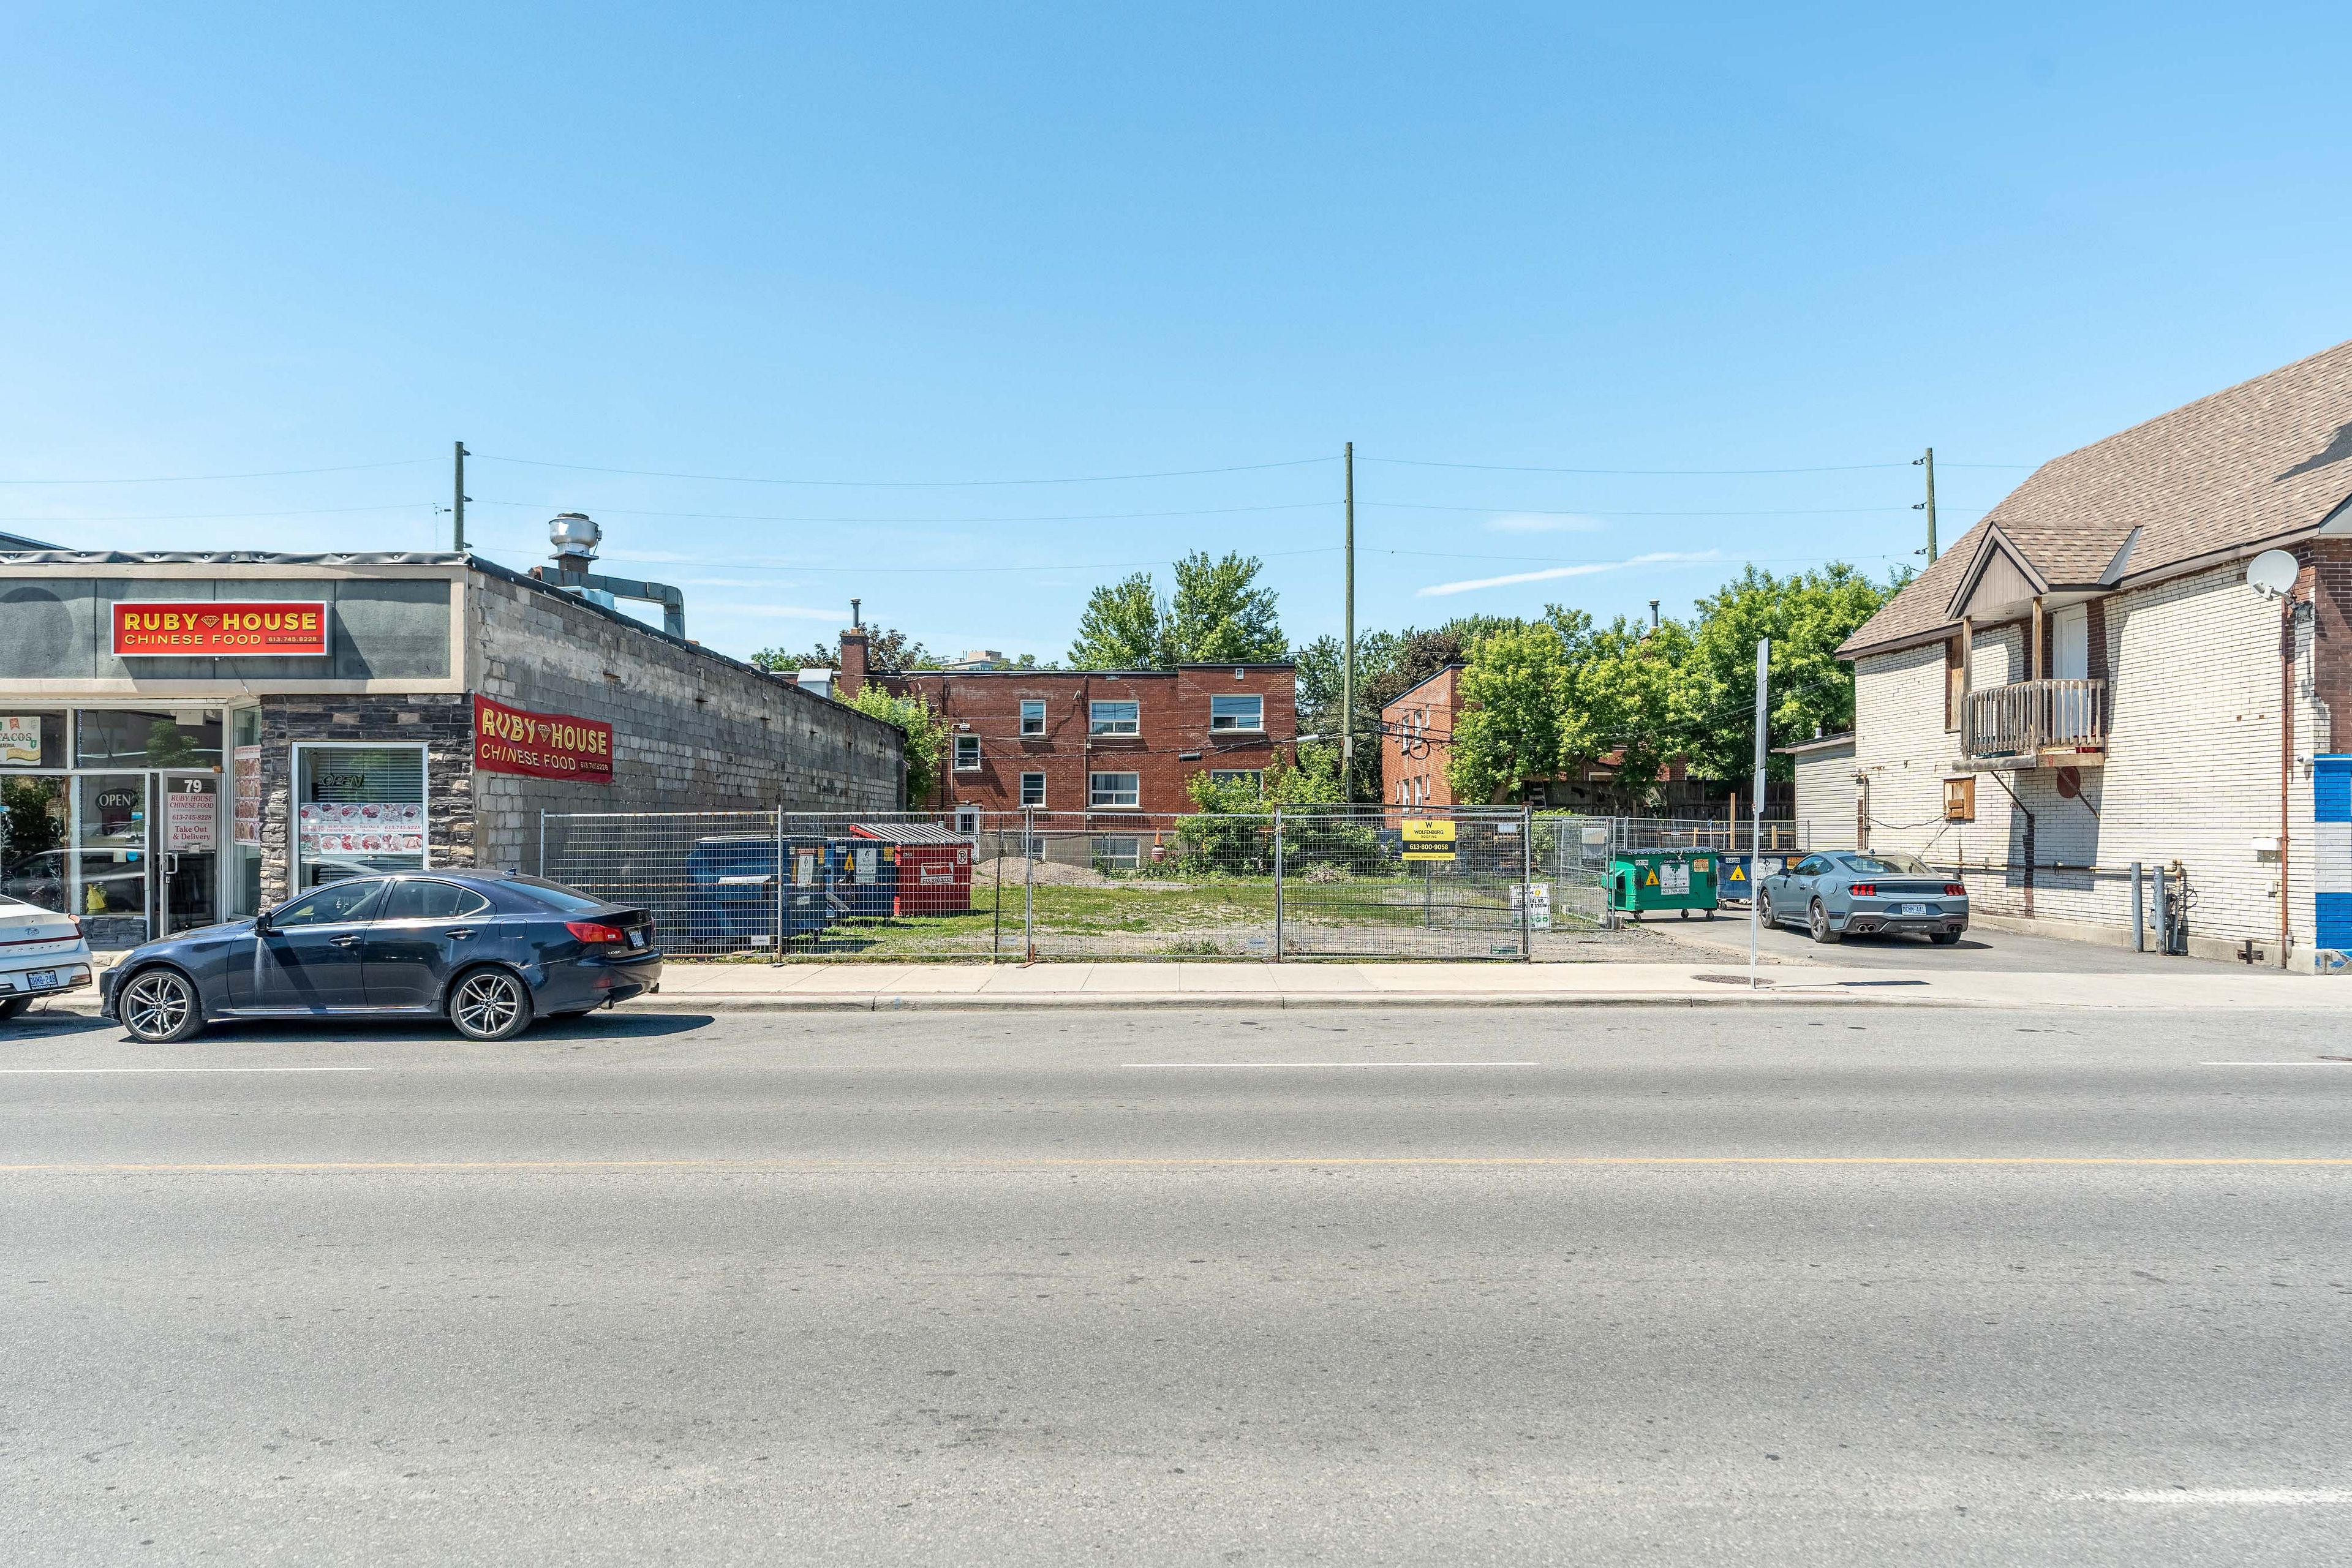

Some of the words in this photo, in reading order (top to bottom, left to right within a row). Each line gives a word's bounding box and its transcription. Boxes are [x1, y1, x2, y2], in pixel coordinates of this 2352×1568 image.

[124, 613, 198, 630] RUBY
[223, 613, 317, 630] HOUSE
[124, 635, 203, 644] CHINESE
[212, 635, 262, 644] FOOD
[483, 707, 536, 744] RUBY
[551, 723, 607, 755] HOUSE
[481, 743, 540, 766] CHINESE
[544, 754, 576, 771] FOOD
[184, 779, 202, 793] 79
[322, 774, 363, 787] OPEN
[99, 794, 130, 806] OPEN
